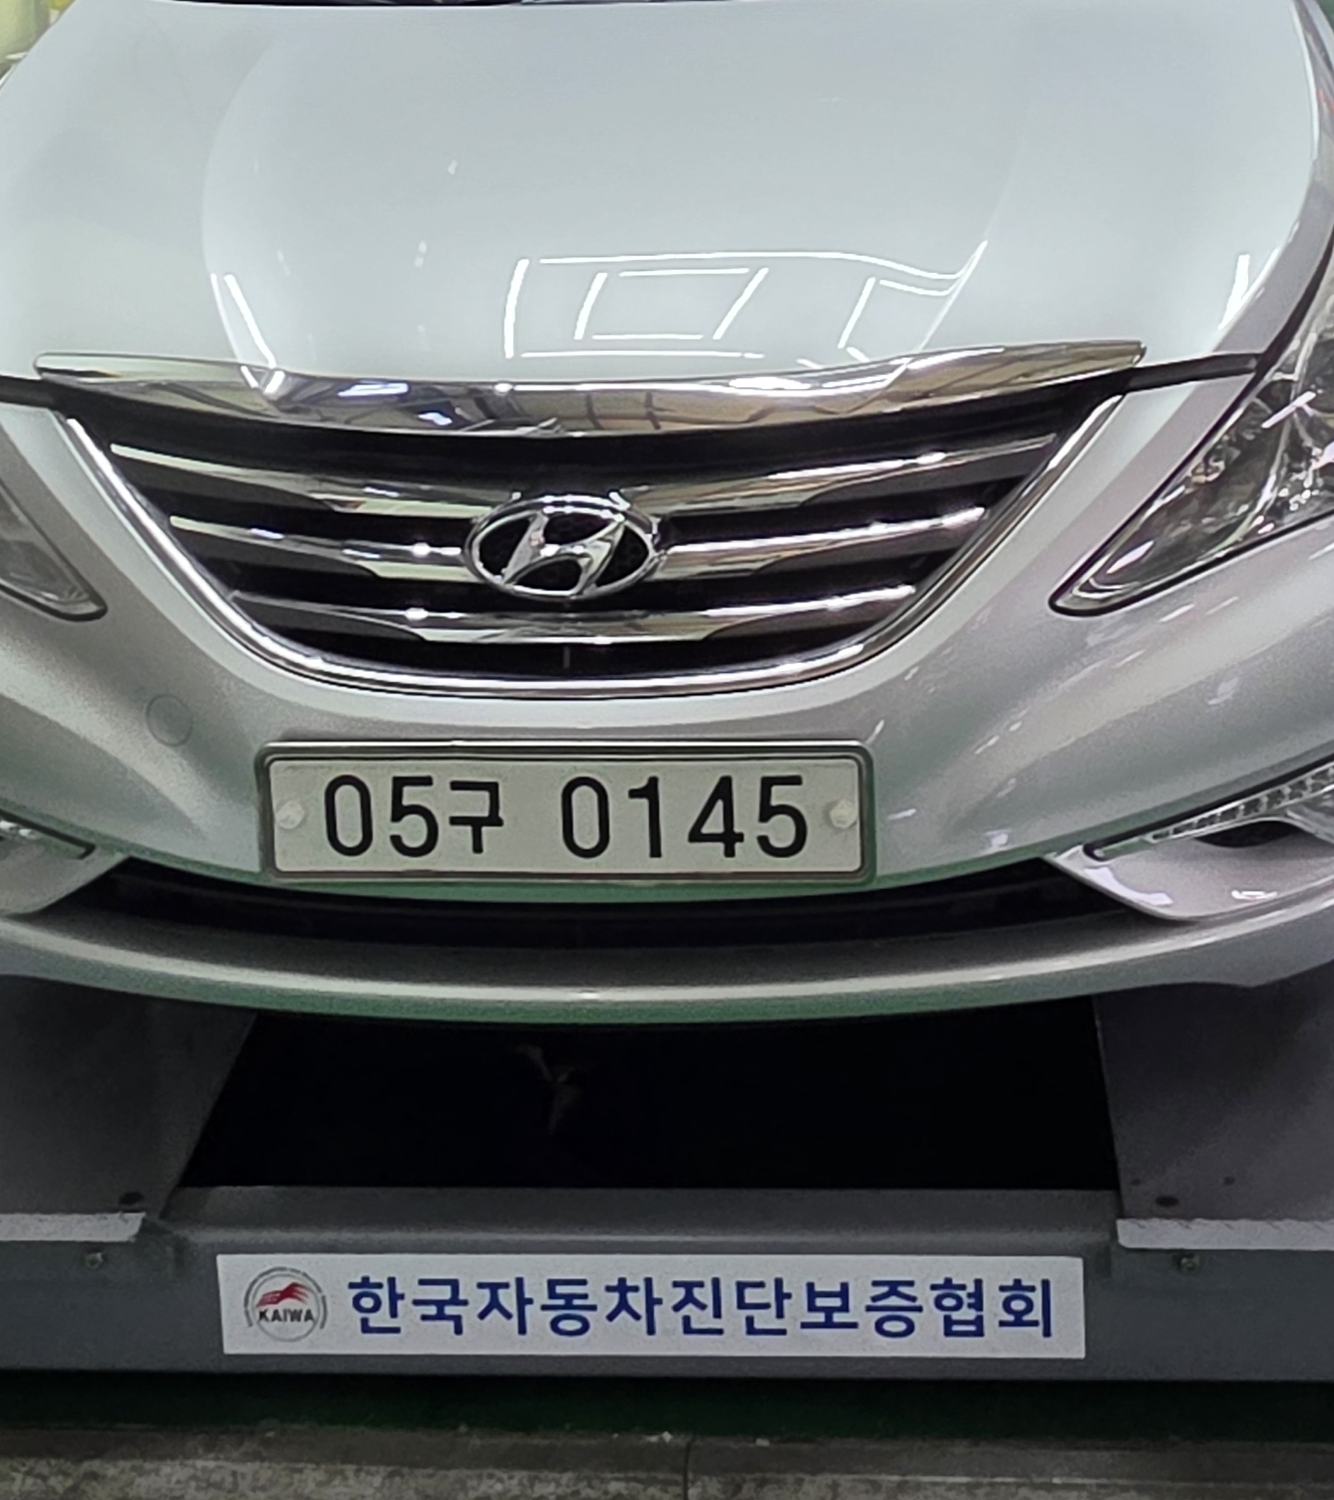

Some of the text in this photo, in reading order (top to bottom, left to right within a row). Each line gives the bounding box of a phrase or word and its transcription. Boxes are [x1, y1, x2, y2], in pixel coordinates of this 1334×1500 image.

[323, 774, 809, 859] 05구 0145
[258, 1308, 315, 1323] KAIWA
[347, 1274, 1055, 1340] 한국자동차진단보증협회
